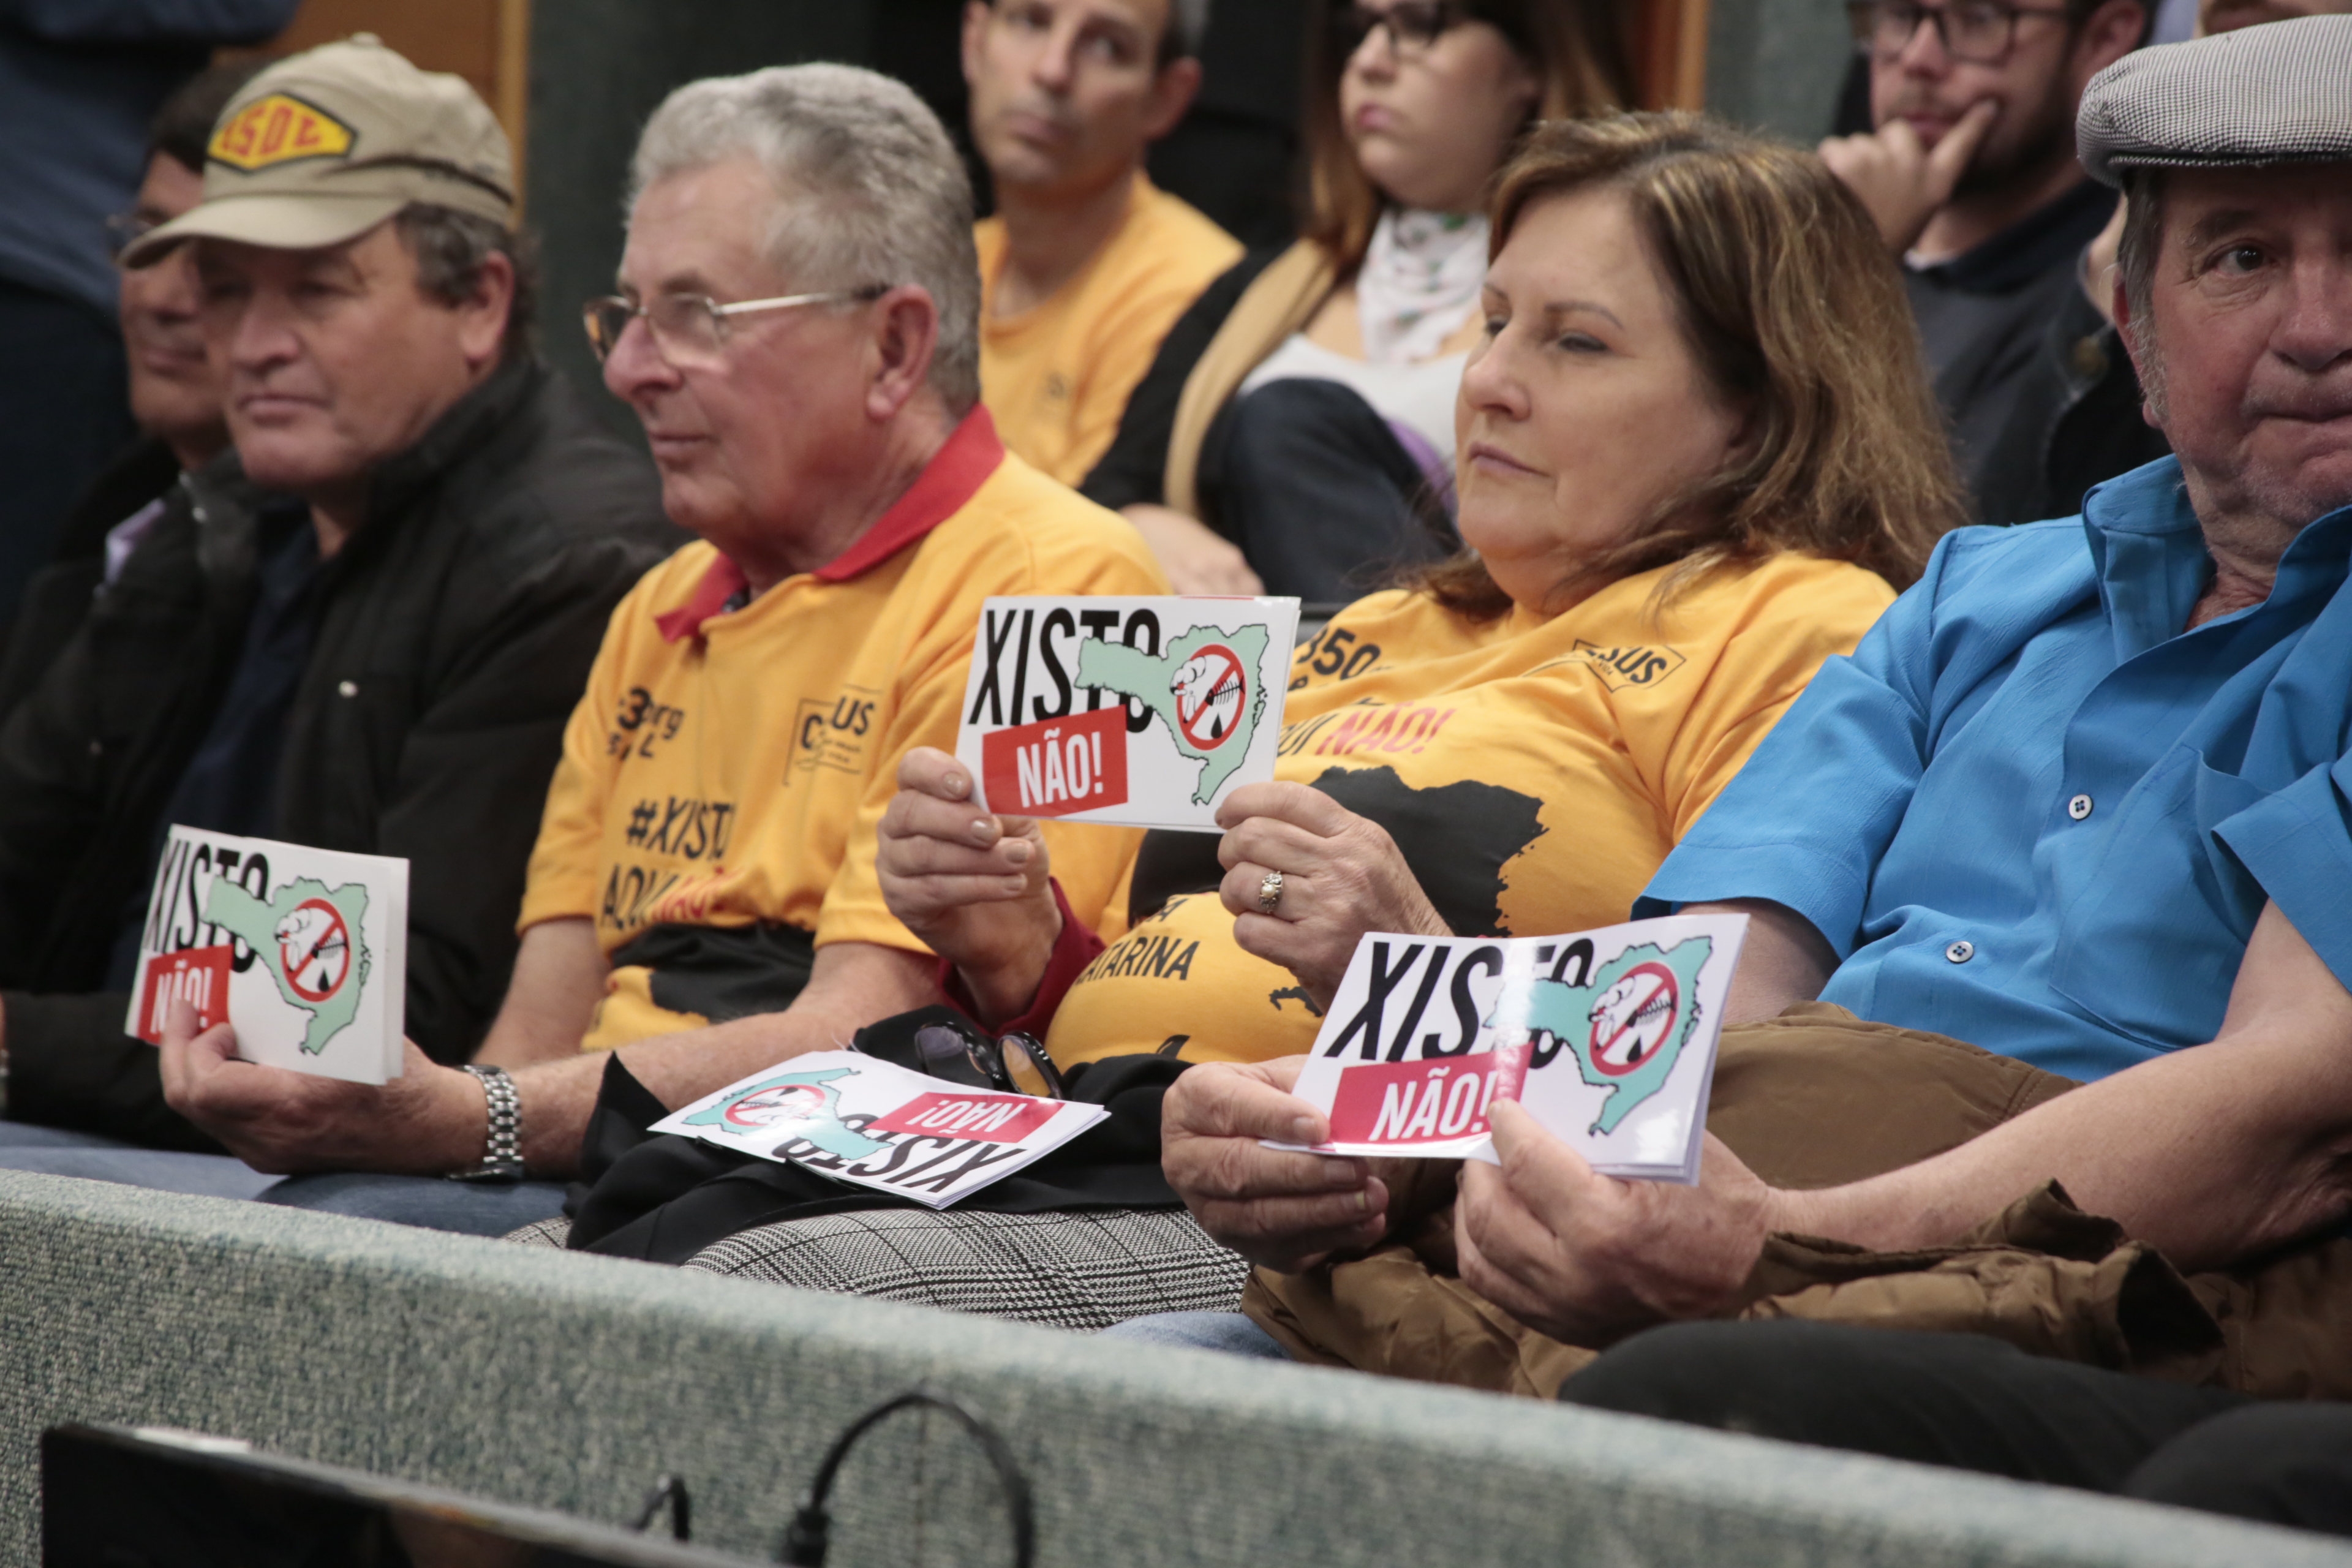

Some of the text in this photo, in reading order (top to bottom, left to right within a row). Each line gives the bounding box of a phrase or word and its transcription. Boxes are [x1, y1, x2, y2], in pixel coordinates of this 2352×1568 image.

[968, 608, 1161, 734] XISTO
[1314, 701, 1459, 756] NÃO!
[1016, 727, 1104, 809] NÃO!
[904, 1099, 1029, 1135] NÃO!
[1367, 1065, 1499, 1142] NÃO!
